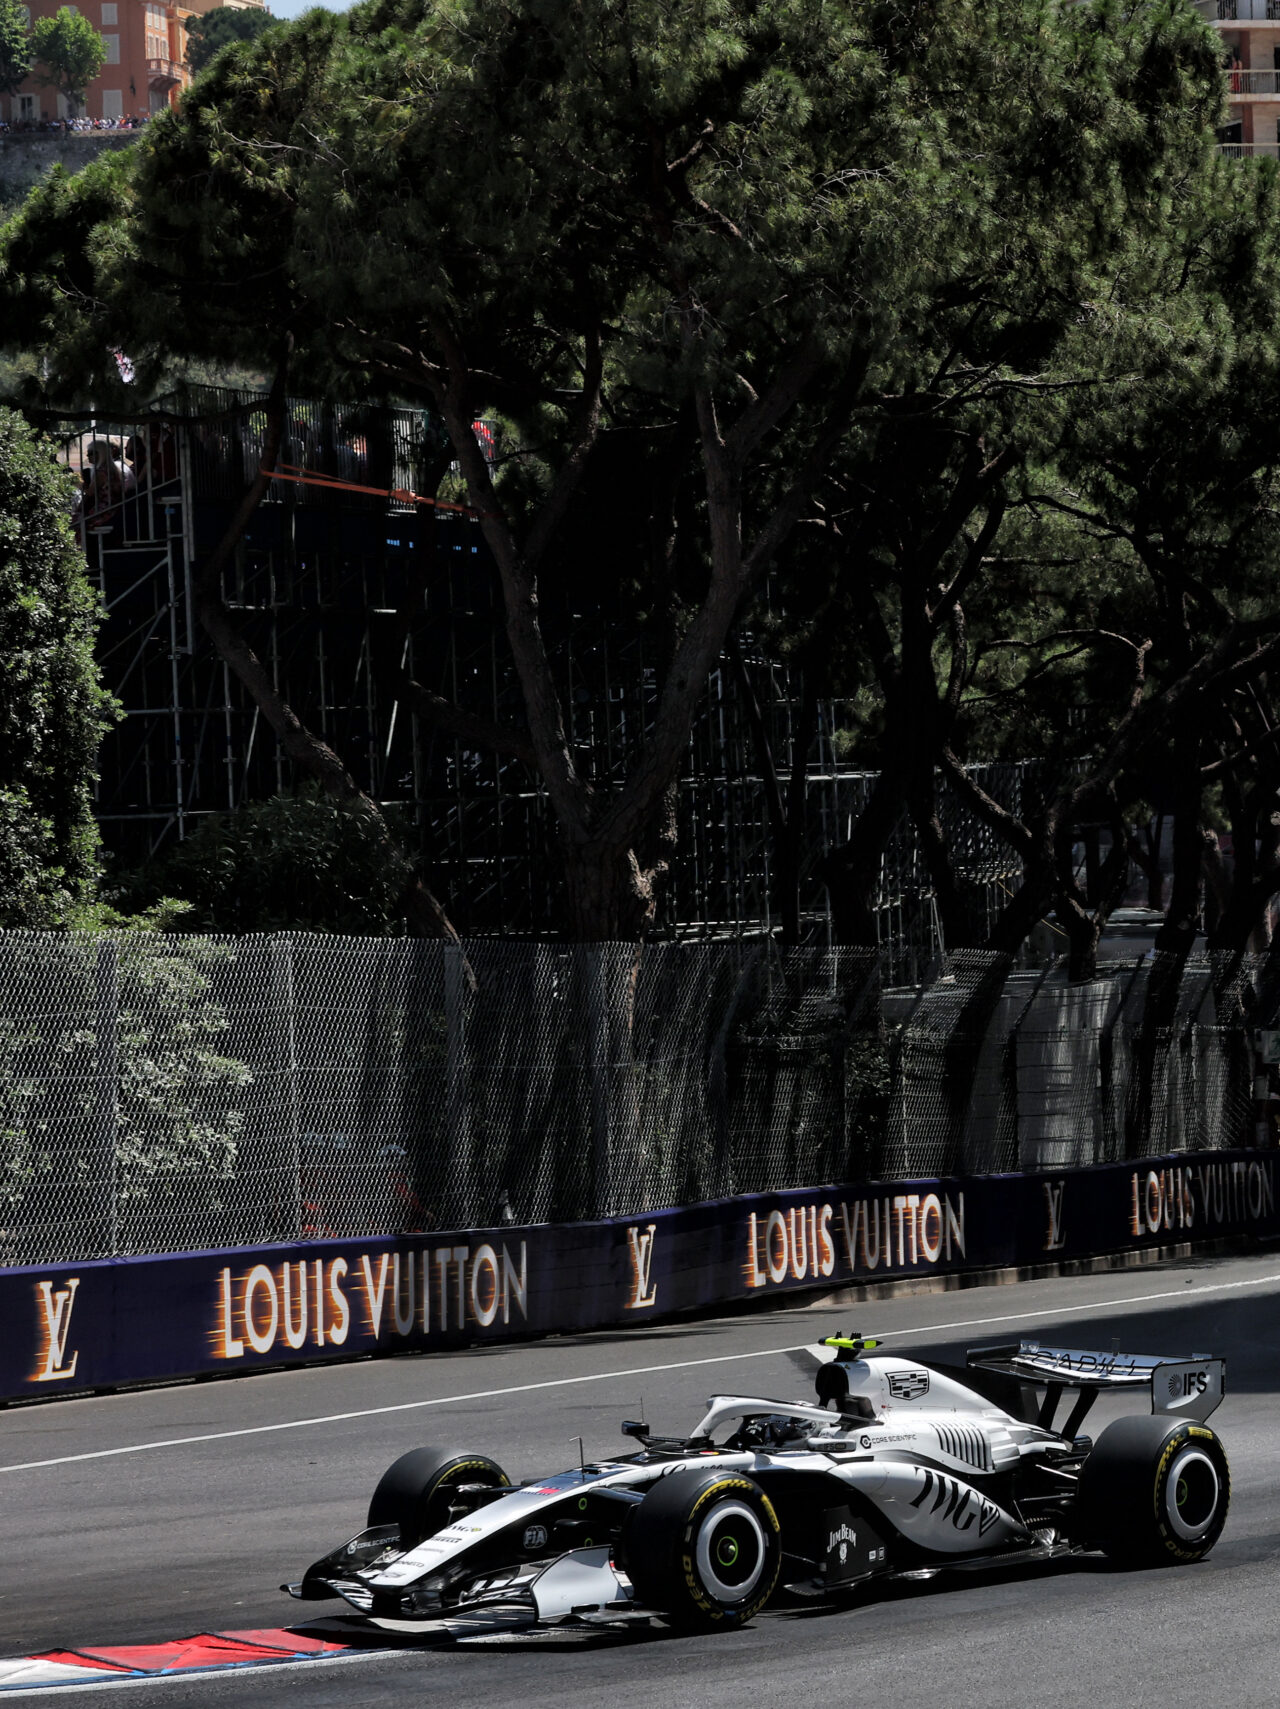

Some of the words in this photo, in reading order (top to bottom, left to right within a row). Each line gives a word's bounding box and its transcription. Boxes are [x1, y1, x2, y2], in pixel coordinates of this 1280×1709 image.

[1132, 1166, 1195, 1236] LOUIS
[1198, 1160, 1275, 1225] VUITTON
[750, 1204, 836, 1287] LOUIS
[841, 1192, 966, 1272] VUITTON
[222, 1257, 350, 1359] LOUIS
[362, 1241, 528, 1340] VUITTON
[1183, 1371, 1207, 1395] IFS
[872, 1437, 888, 1445] CORE
[889, 1434, 917, 1443] SCIENTIFIC
[909, 1466, 979, 1531] TWG
[525, 1531, 545, 1545] FIA
[826, 1528, 842, 1553] JIM
[841, 1523, 857, 1548] BEAM
